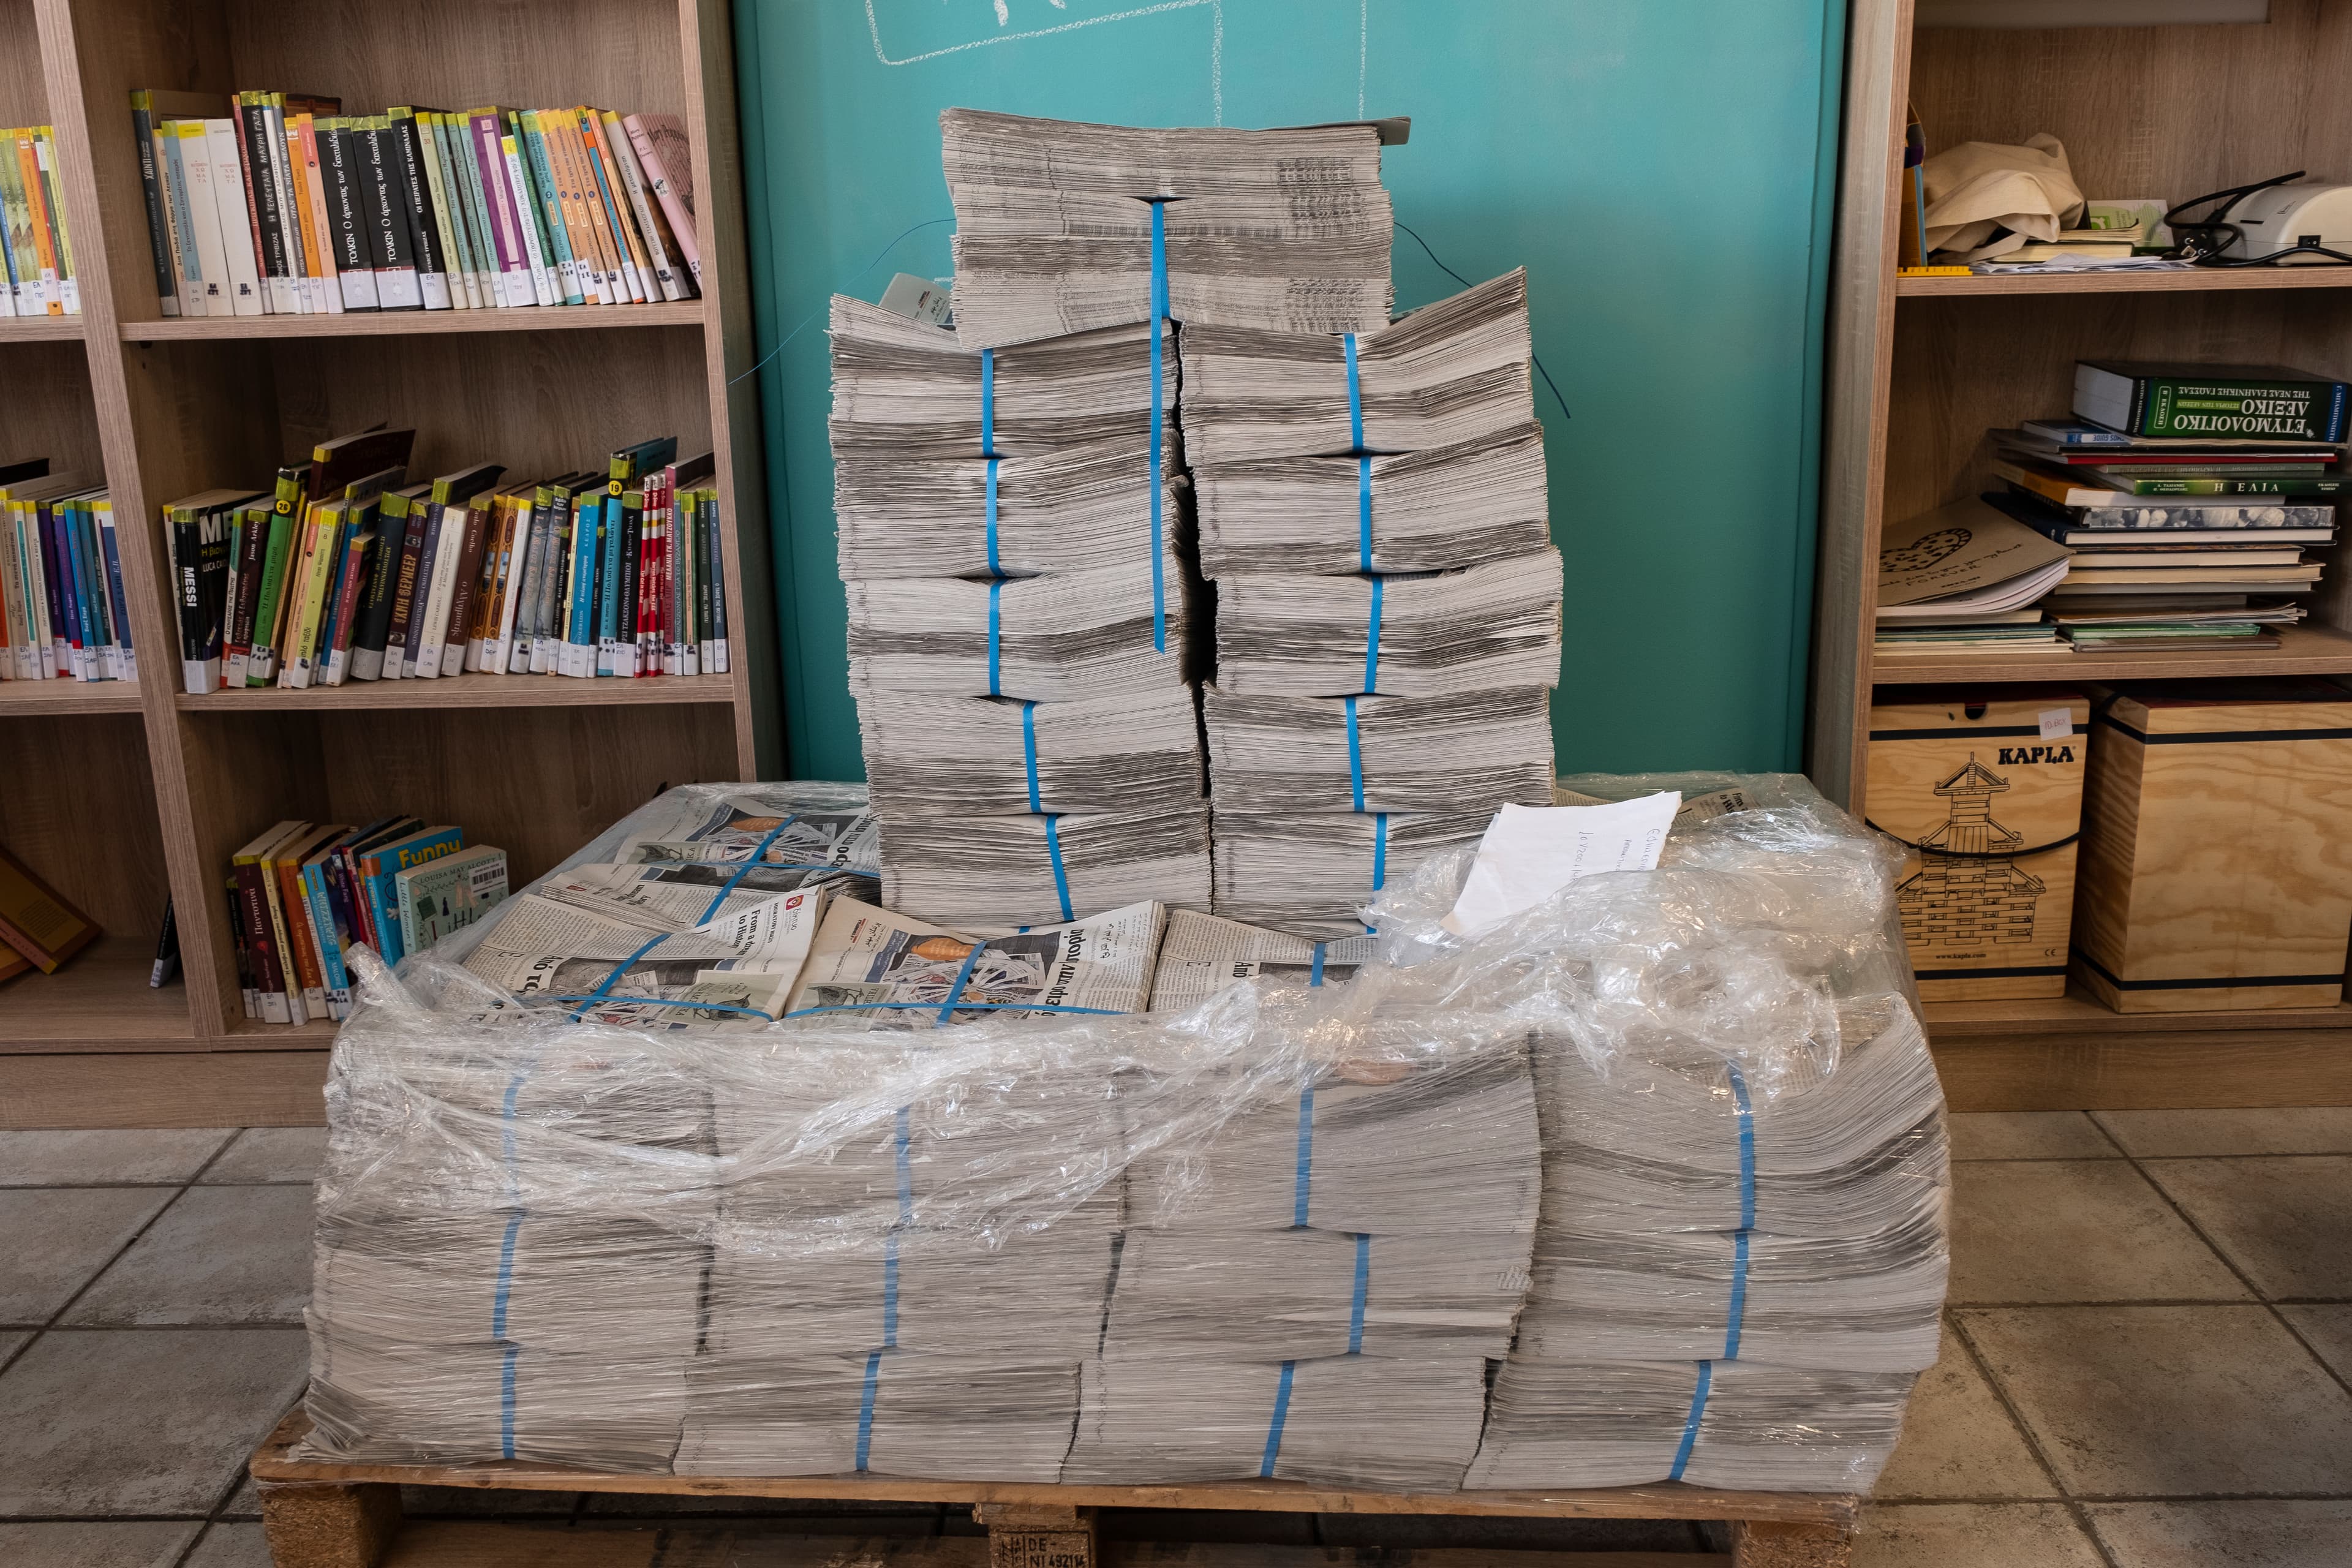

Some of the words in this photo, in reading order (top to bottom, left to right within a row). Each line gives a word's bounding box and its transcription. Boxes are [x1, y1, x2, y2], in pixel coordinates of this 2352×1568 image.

[252, 109, 262, 130] ΓΑΤΑ
[256, 134, 268, 162] ΜΑΥΡΗ
[279, 132, 288, 161] ΘΕΛΟΥΝ
[401, 125, 414, 162] ΚΑΜΙΝΑΔΑΣ
[172, 159, 181, 180] ποταμός
[272, 155, 281, 187] ΔΕΛΦΙΝΑΣ
[337, 170, 345, 184] των
[622, 156, 638, 187] μετακόμιση
[261, 168, 275, 211] ΤΕΛΕΥΤΑΙΑ
[288, 187, 294, 198] ΤΑ
[378, 183, 391, 216] άρχοντας
[410, 176, 421, 205] ΠΕΙΡΑΤΕΣ
[248, 189, 258, 227] ΠΡΙΓΚΙΠΑΣ
[339, 186, 352, 219] άρχοντας
[271, 232, 282, 258] ΤΡΙΒΙΖΑΣ
[345, 233, 358, 265] ΤΟΛΚΙΝ
[384, 230, 397, 262] ΤΟΛΚΙΝ
[421, 231, 430, 252] ΤΡΙΒΙΖΑΣ
[2178, 386, 2216, 396] ΓΛΩΣΣΑΣ
[2217, 388, 2267, 397] ΕΛΛΗΝΙΚΗΣ
[2269, 390, 2292, 398] ΝΕΑΣ
[2293, 390, 2310, 399] ΤΗΣ
[2158, 398, 2167, 425] ΕΚΔΟΣΗ
[2241, 399, 2310, 417] ΛΕΞΙΚΟ
[2328, 392, 2341, 442] ΜΠΑΜΠΙΝΙΩΤΗ
[2174, 415, 2307, 434] ΕΤΥΜΟΛΟΓΙΚΟ
[609, 483, 620, 493] 19
[2214, 483, 2223, 492] Η
[2237, 483, 2279, 492] ΕΛΙΑ
[250, 521, 260, 542] Arkley
[467, 529, 478, 552] Coelho
[607, 519, 616, 556] μεγαλώνει
[247, 543, 257, 560] Jason
[377, 535, 386, 560] ΙΣΤΟΡΙΕΣ
[376, 545, 391, 603] ΧΡΙΣΤΟΥΓΕΝΝΙΑΤΙΚΕΣ
[398, 554, 417, 597] ΒΕΡΜΕΕΡ
[421, 562, 432, 589] ΜΥΣΤΗΡΙΟ
[604, 557, 613, 594] Πολυάννα
[675, 566, 680, 576] ΤΟ
[1906, 565, 1981, 586] FOREVER
[115, 576, 123, 595] ΣΑΡΗ
[183, 567, 198, 607] MESSI
[368, 573, 379, 609] ΦΑΝΤΑΣΜΑΤΑ
[118, 597, 126, 616] ΖΩΡΖ
[451, 589, 469, 637] Αλχημιστής
[303, 627, 311, 643] ταξίδι
[411, 601, 424, 646] ΧΡΙΣΤΟΥΓΕΝΝΩΝ
[1998, 746, 2075, 765] KAPLA
[839, 833, 861, 845] στην
[398, 839, 461, 869] Funny
[338, 872, 347, 888] White
[420, 871, 447, 884] LOUISA
[450, 867, 465, 876] MAY
[467, 857, 496, 870] ALCOTT
[1570, 870, 1583, 882] 148
[368, 882, 377, 908] STORIES
[245, 888, 265, 935] Παντοτινά
[317, 891, 337, 946] WHIZZIWIG
[739, 914, 747, 924] to
[749, 909, 761, 933] From
[769, 902, 779, 930] MIGRATORY
[791, 908, 801, 930] δίκτυο
[736, 941, 755, 956] dream
[281, 953, 289, 970] καλύβα
[303, 965, 312, 978] Χακ
[532, 954, 565, 971] Από
[1232, 960, 1254, 978] Από
[1035, 986, 1069, 1017] όειρο
[1056, 963, 1076, 986] στην
[1030, 1555, 1045, 1568] NI
